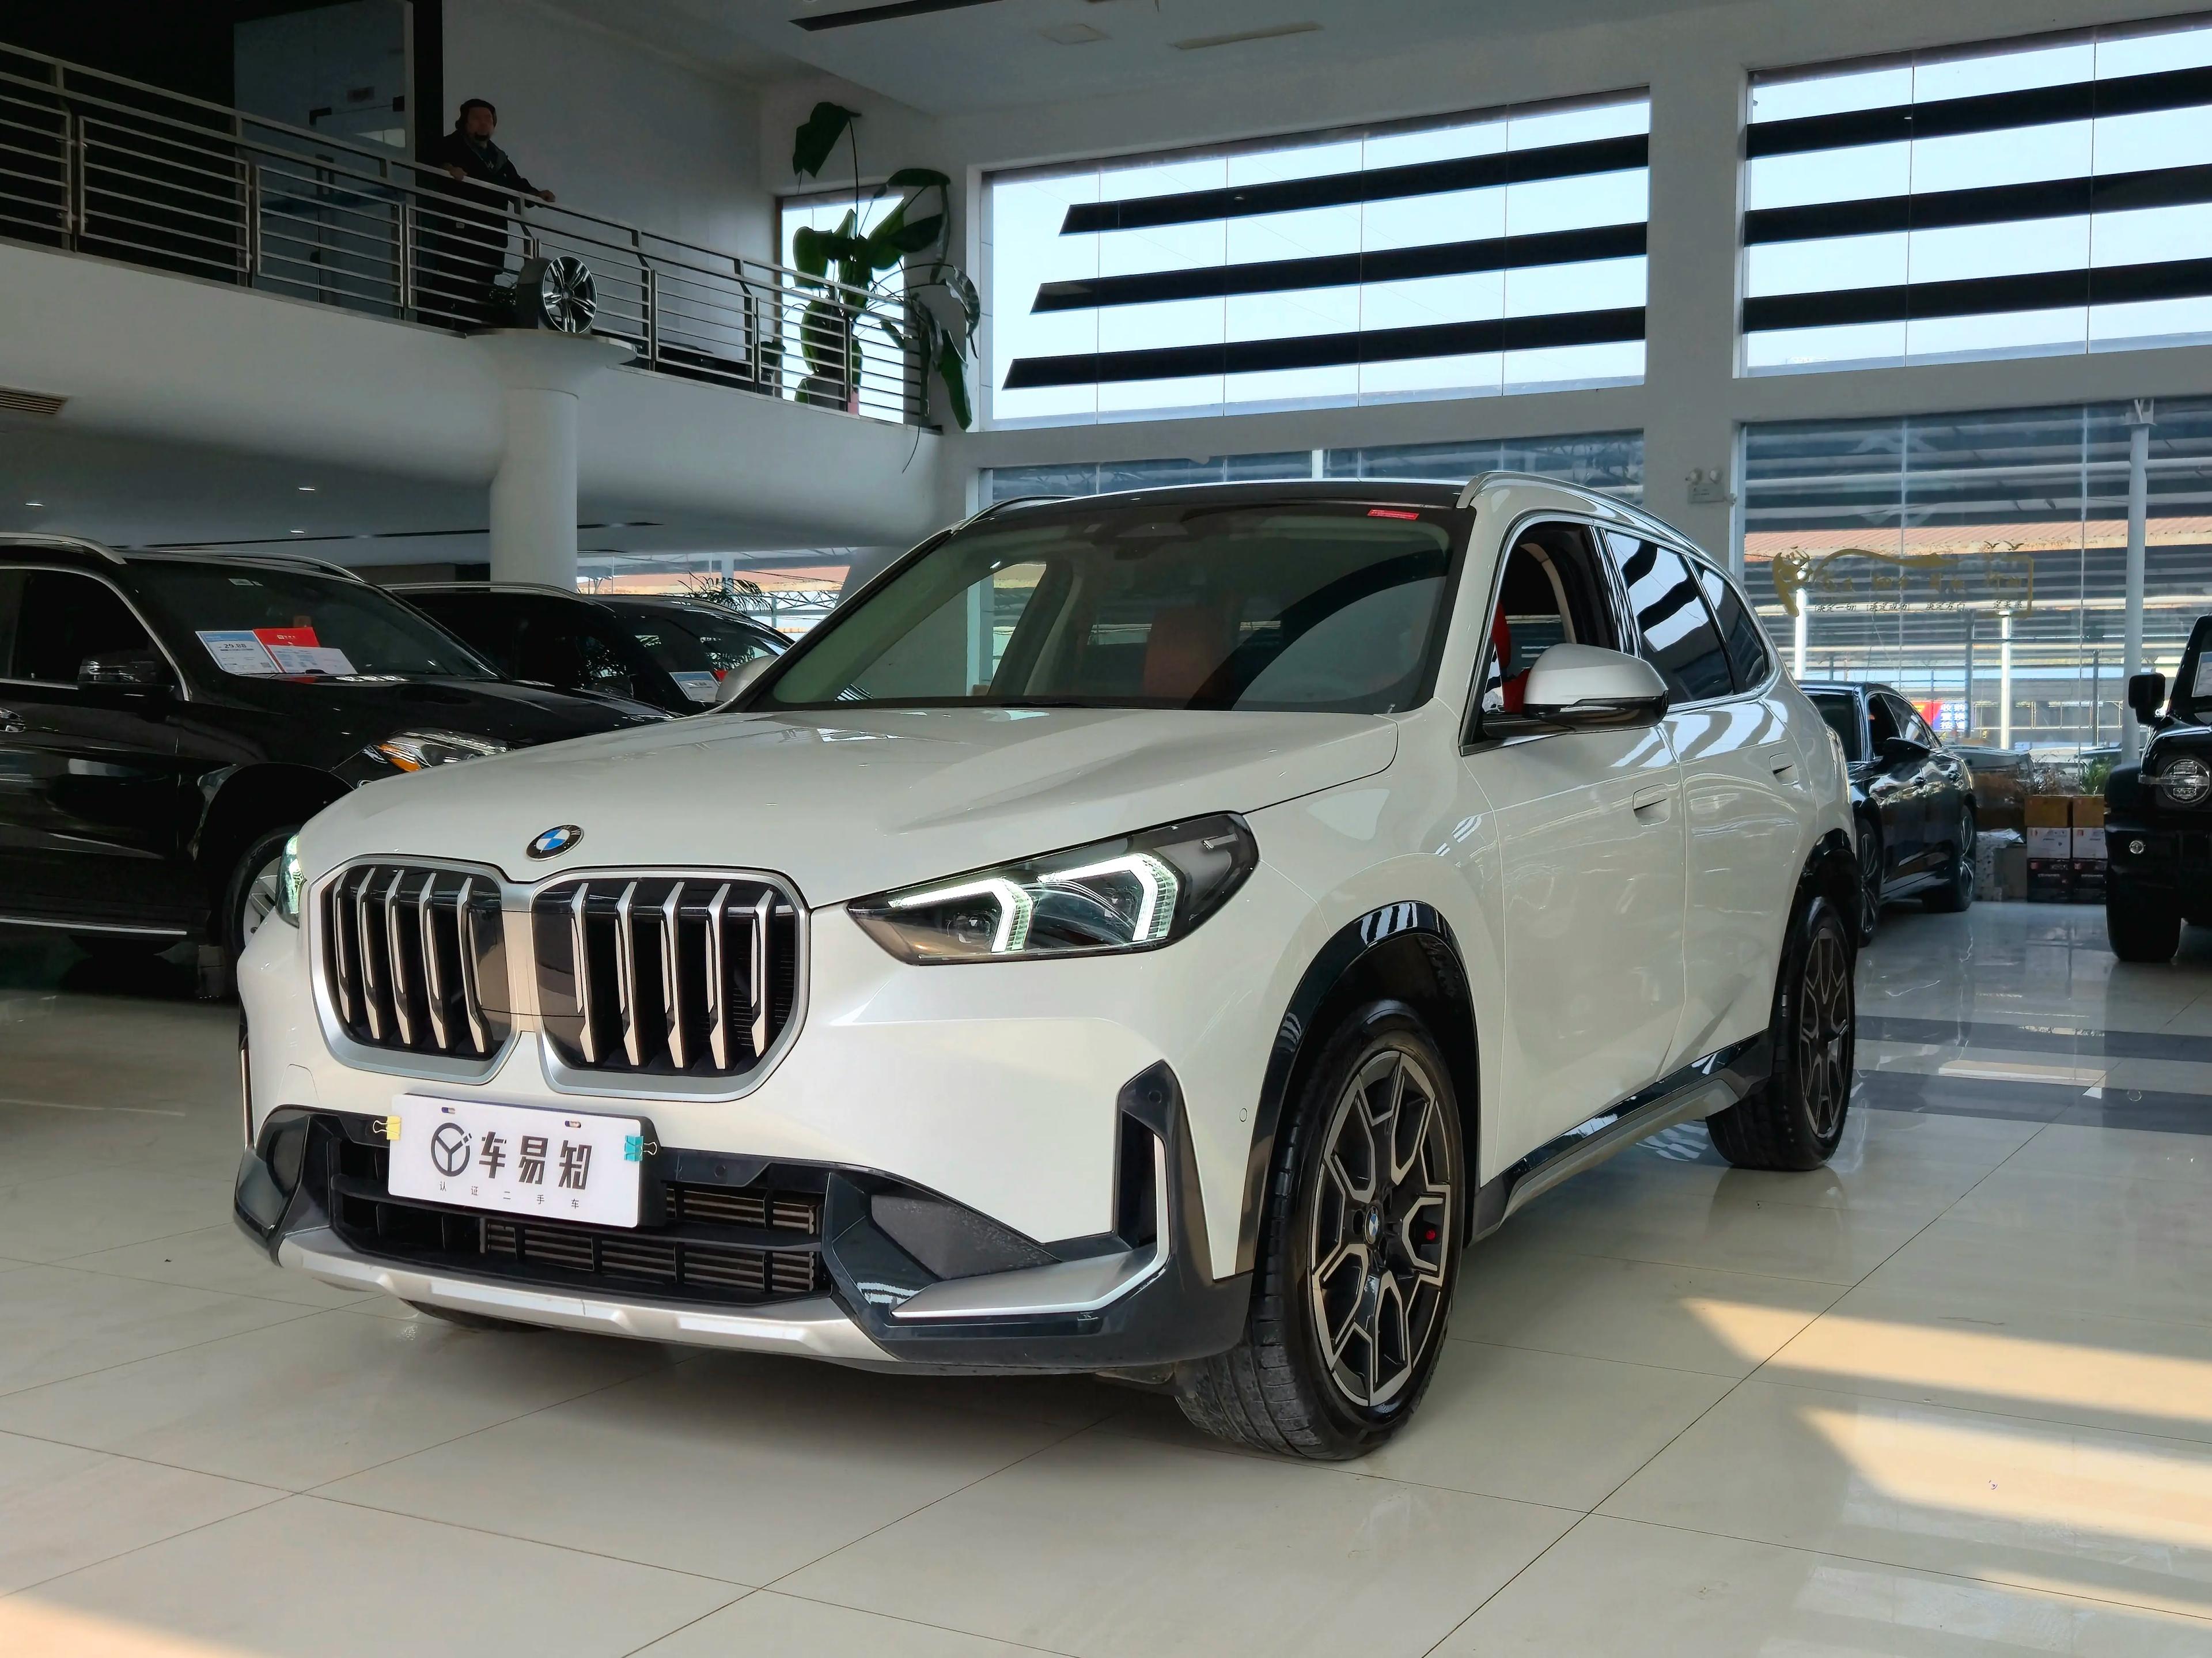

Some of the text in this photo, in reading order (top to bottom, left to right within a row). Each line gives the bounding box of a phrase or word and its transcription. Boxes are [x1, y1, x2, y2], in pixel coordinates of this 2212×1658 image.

[479, 1131, 593, 1190] 车易知
[440, 1180, 579, 1209] 认证二手车
